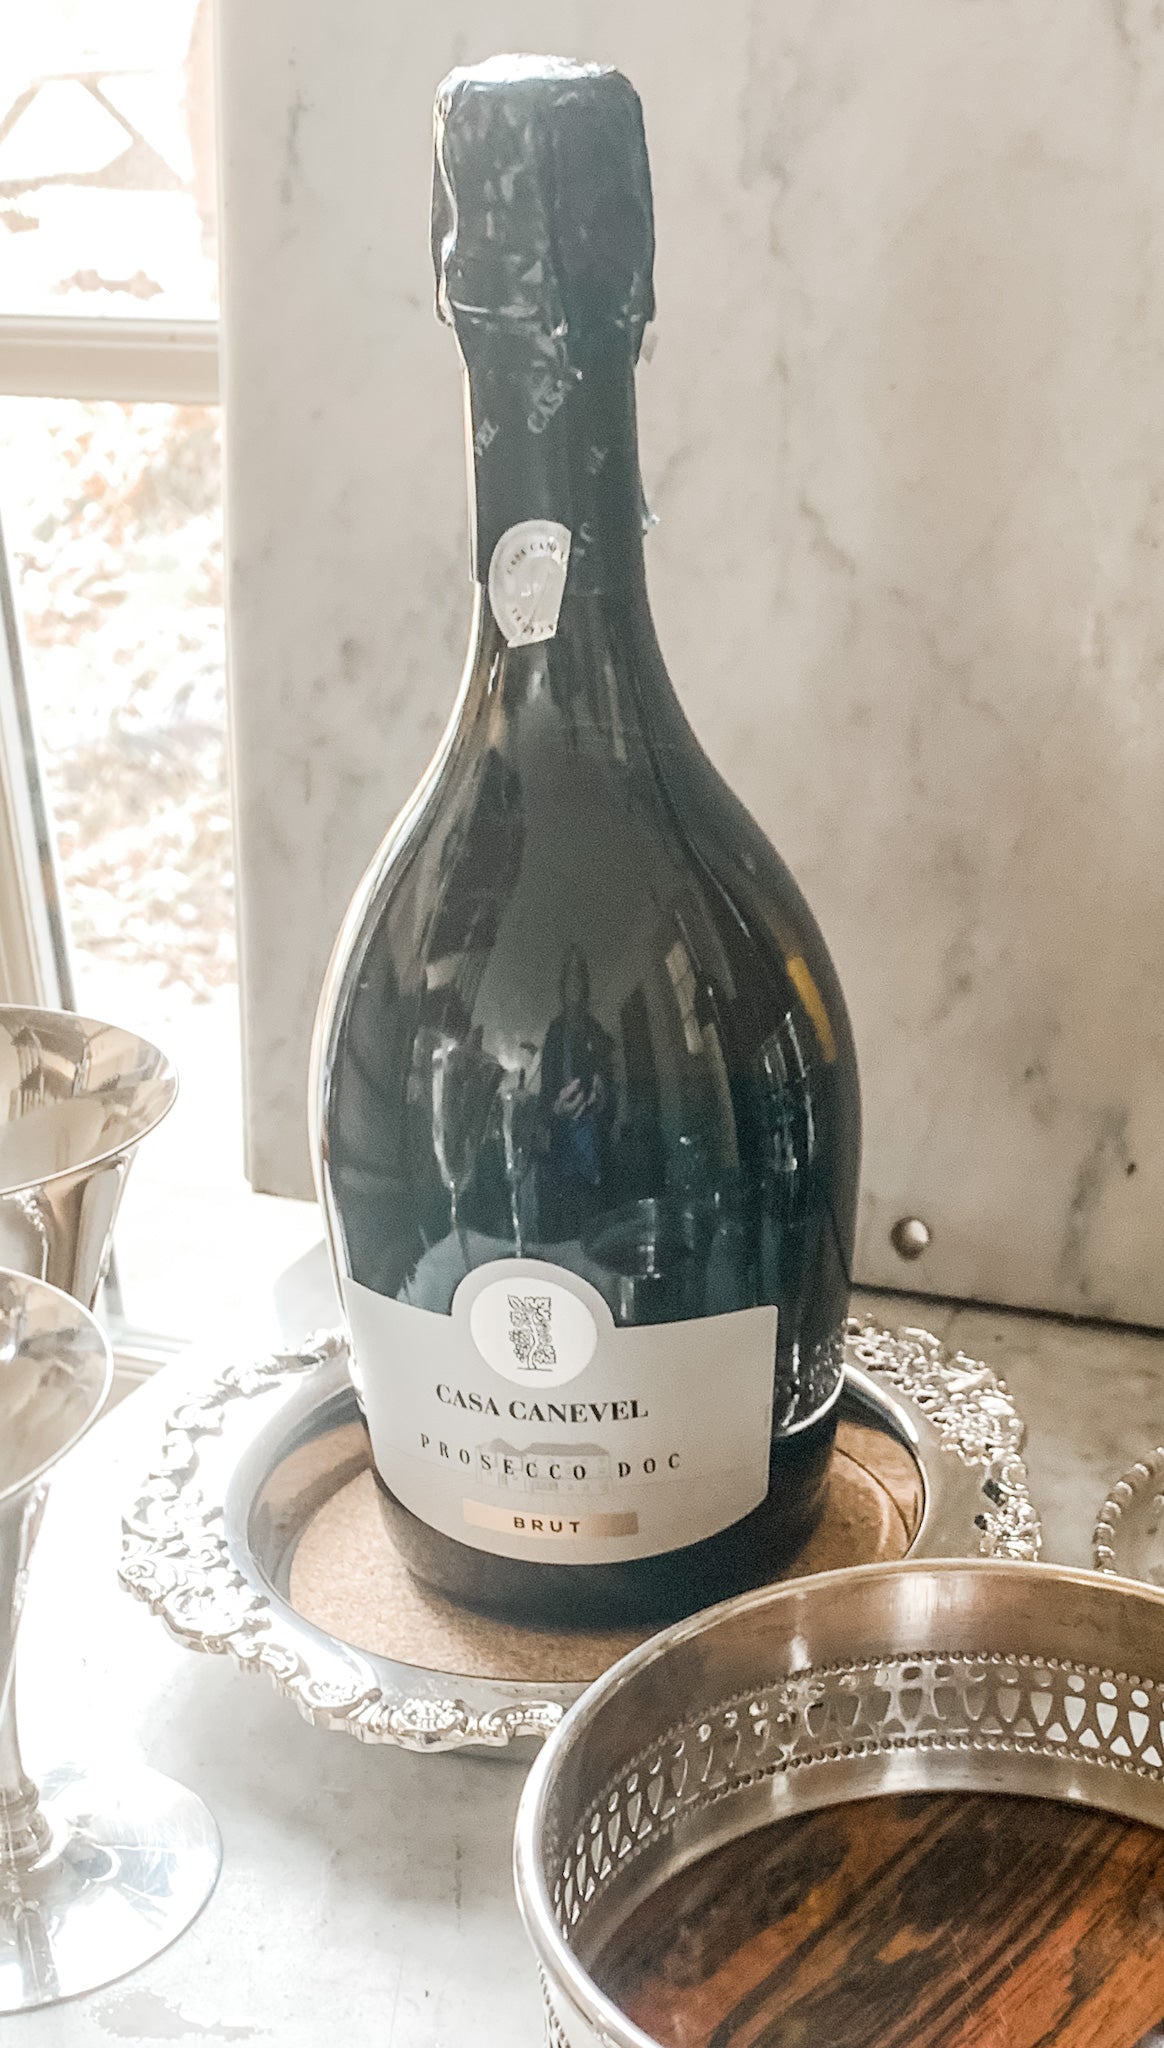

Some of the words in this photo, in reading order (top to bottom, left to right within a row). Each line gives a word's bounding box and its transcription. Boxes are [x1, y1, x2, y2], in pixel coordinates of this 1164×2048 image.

[435, 1383, 501, 1417] CASA
[508, 1399, 649, 1424] CANEVEL
[420, 1432, 587, 1481] PROSECCO
[618, 1452, 681, 1478] DOC
[513, 1516, 581, 1534] BRUT
